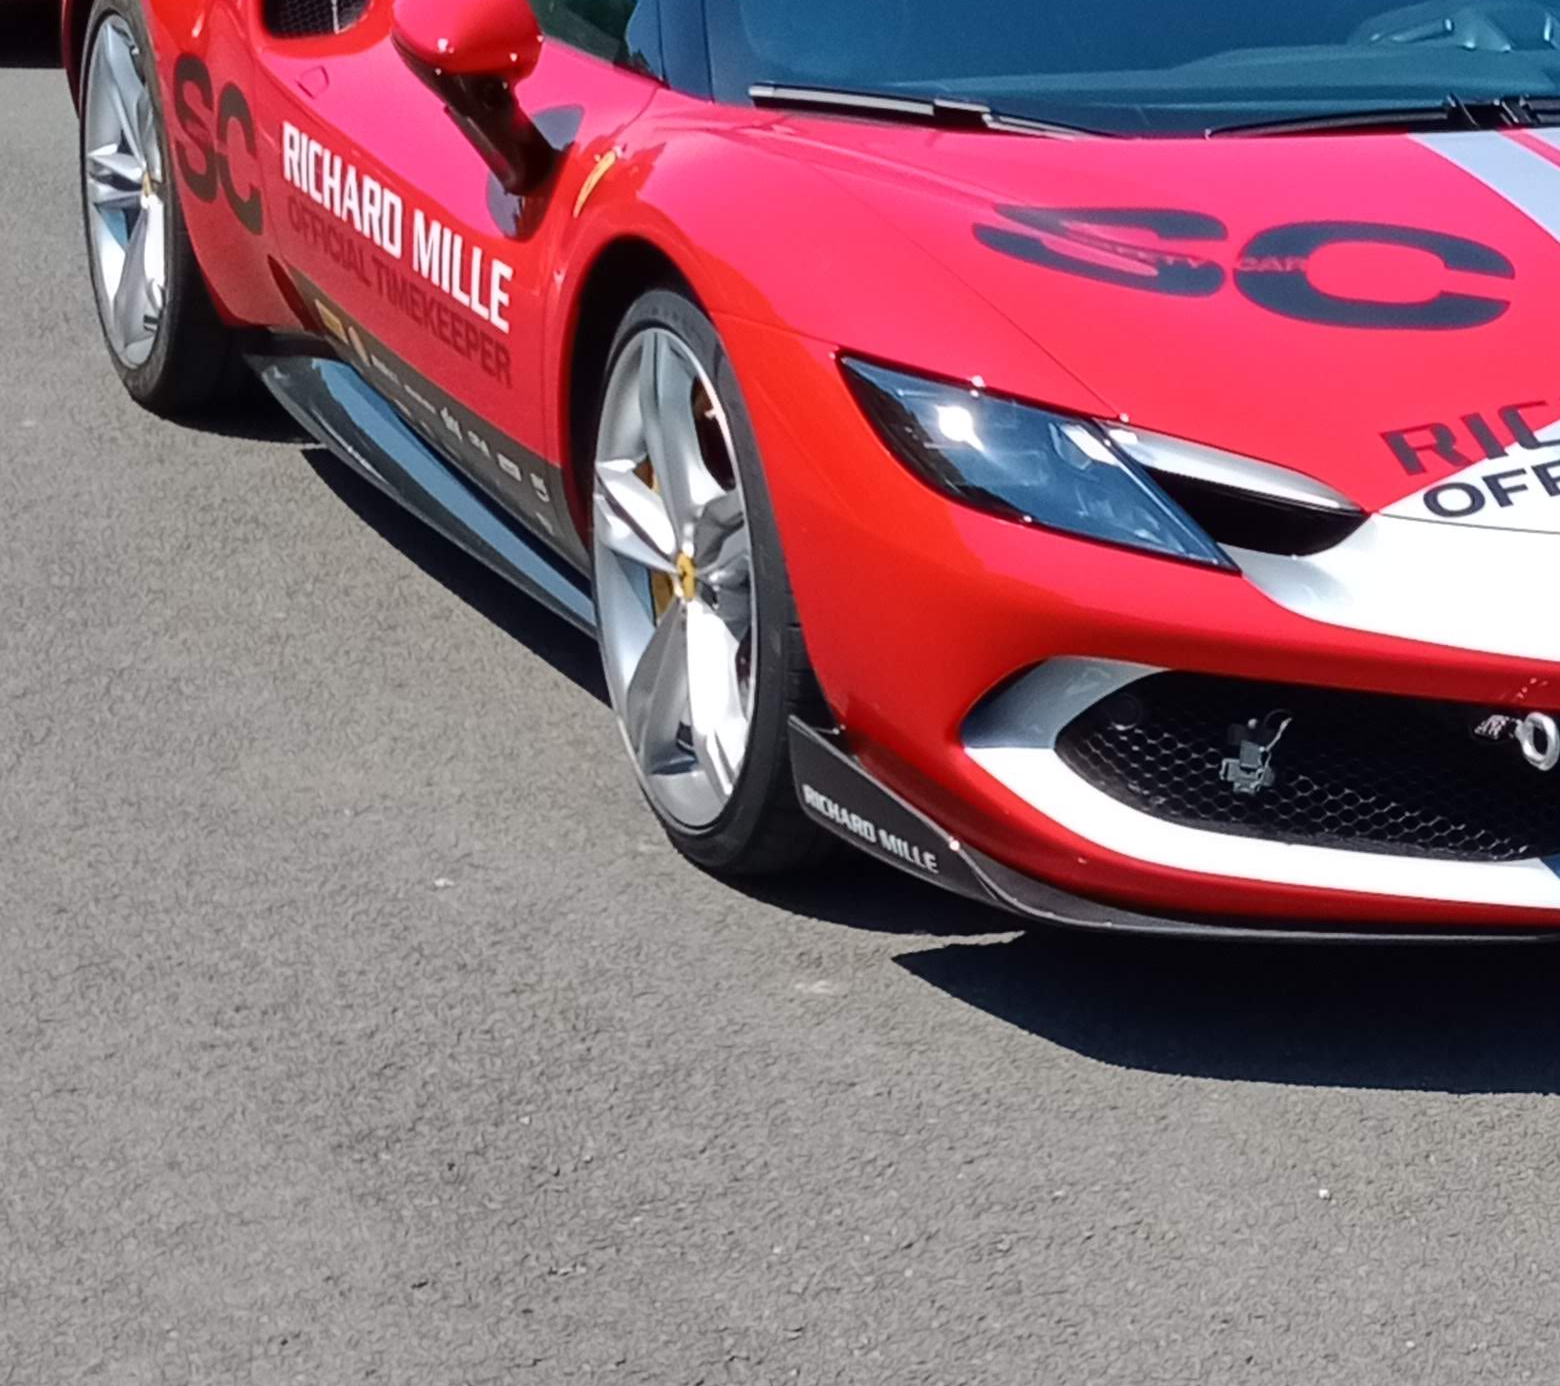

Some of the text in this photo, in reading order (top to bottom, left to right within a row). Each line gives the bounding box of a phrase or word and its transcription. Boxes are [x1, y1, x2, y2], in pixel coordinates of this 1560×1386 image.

[174, 51, 264, 237] SC
[283, 120, 514, 335] RICHARD MILLE
[288, 195, 513, 390] OFFICIAL TIMEKEEPER
[971, 202, 1517, 332] SC
[801, 783, 940, 875] RICHARD MILLE
